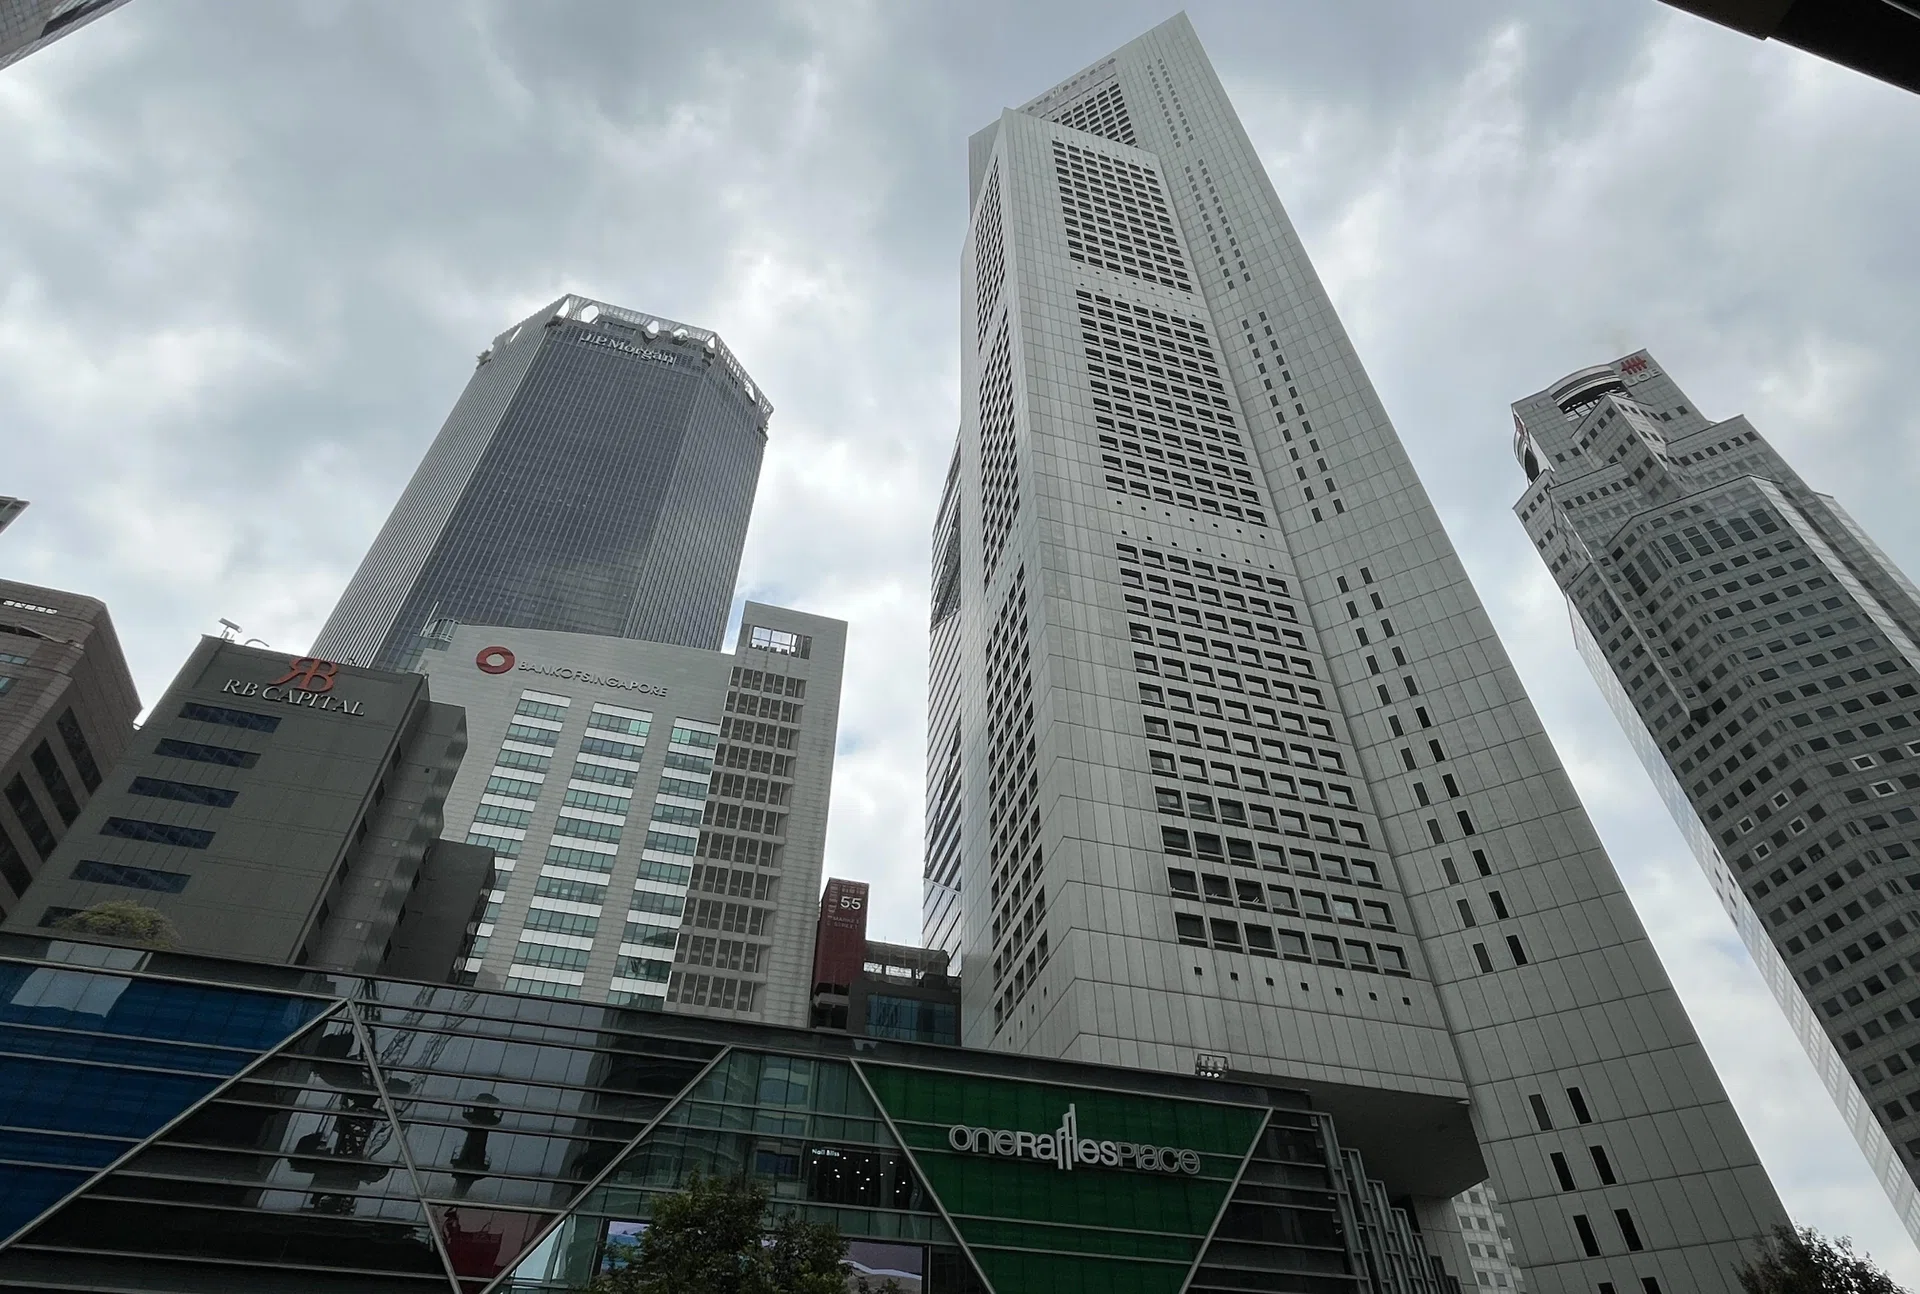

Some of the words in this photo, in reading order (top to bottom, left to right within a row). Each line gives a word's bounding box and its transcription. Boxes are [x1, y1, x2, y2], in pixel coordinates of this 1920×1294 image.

[222, 679, 258, 696] RB
[262, 686, 364, 716] CAPITAL
[840, 896, 862, 910] 55
